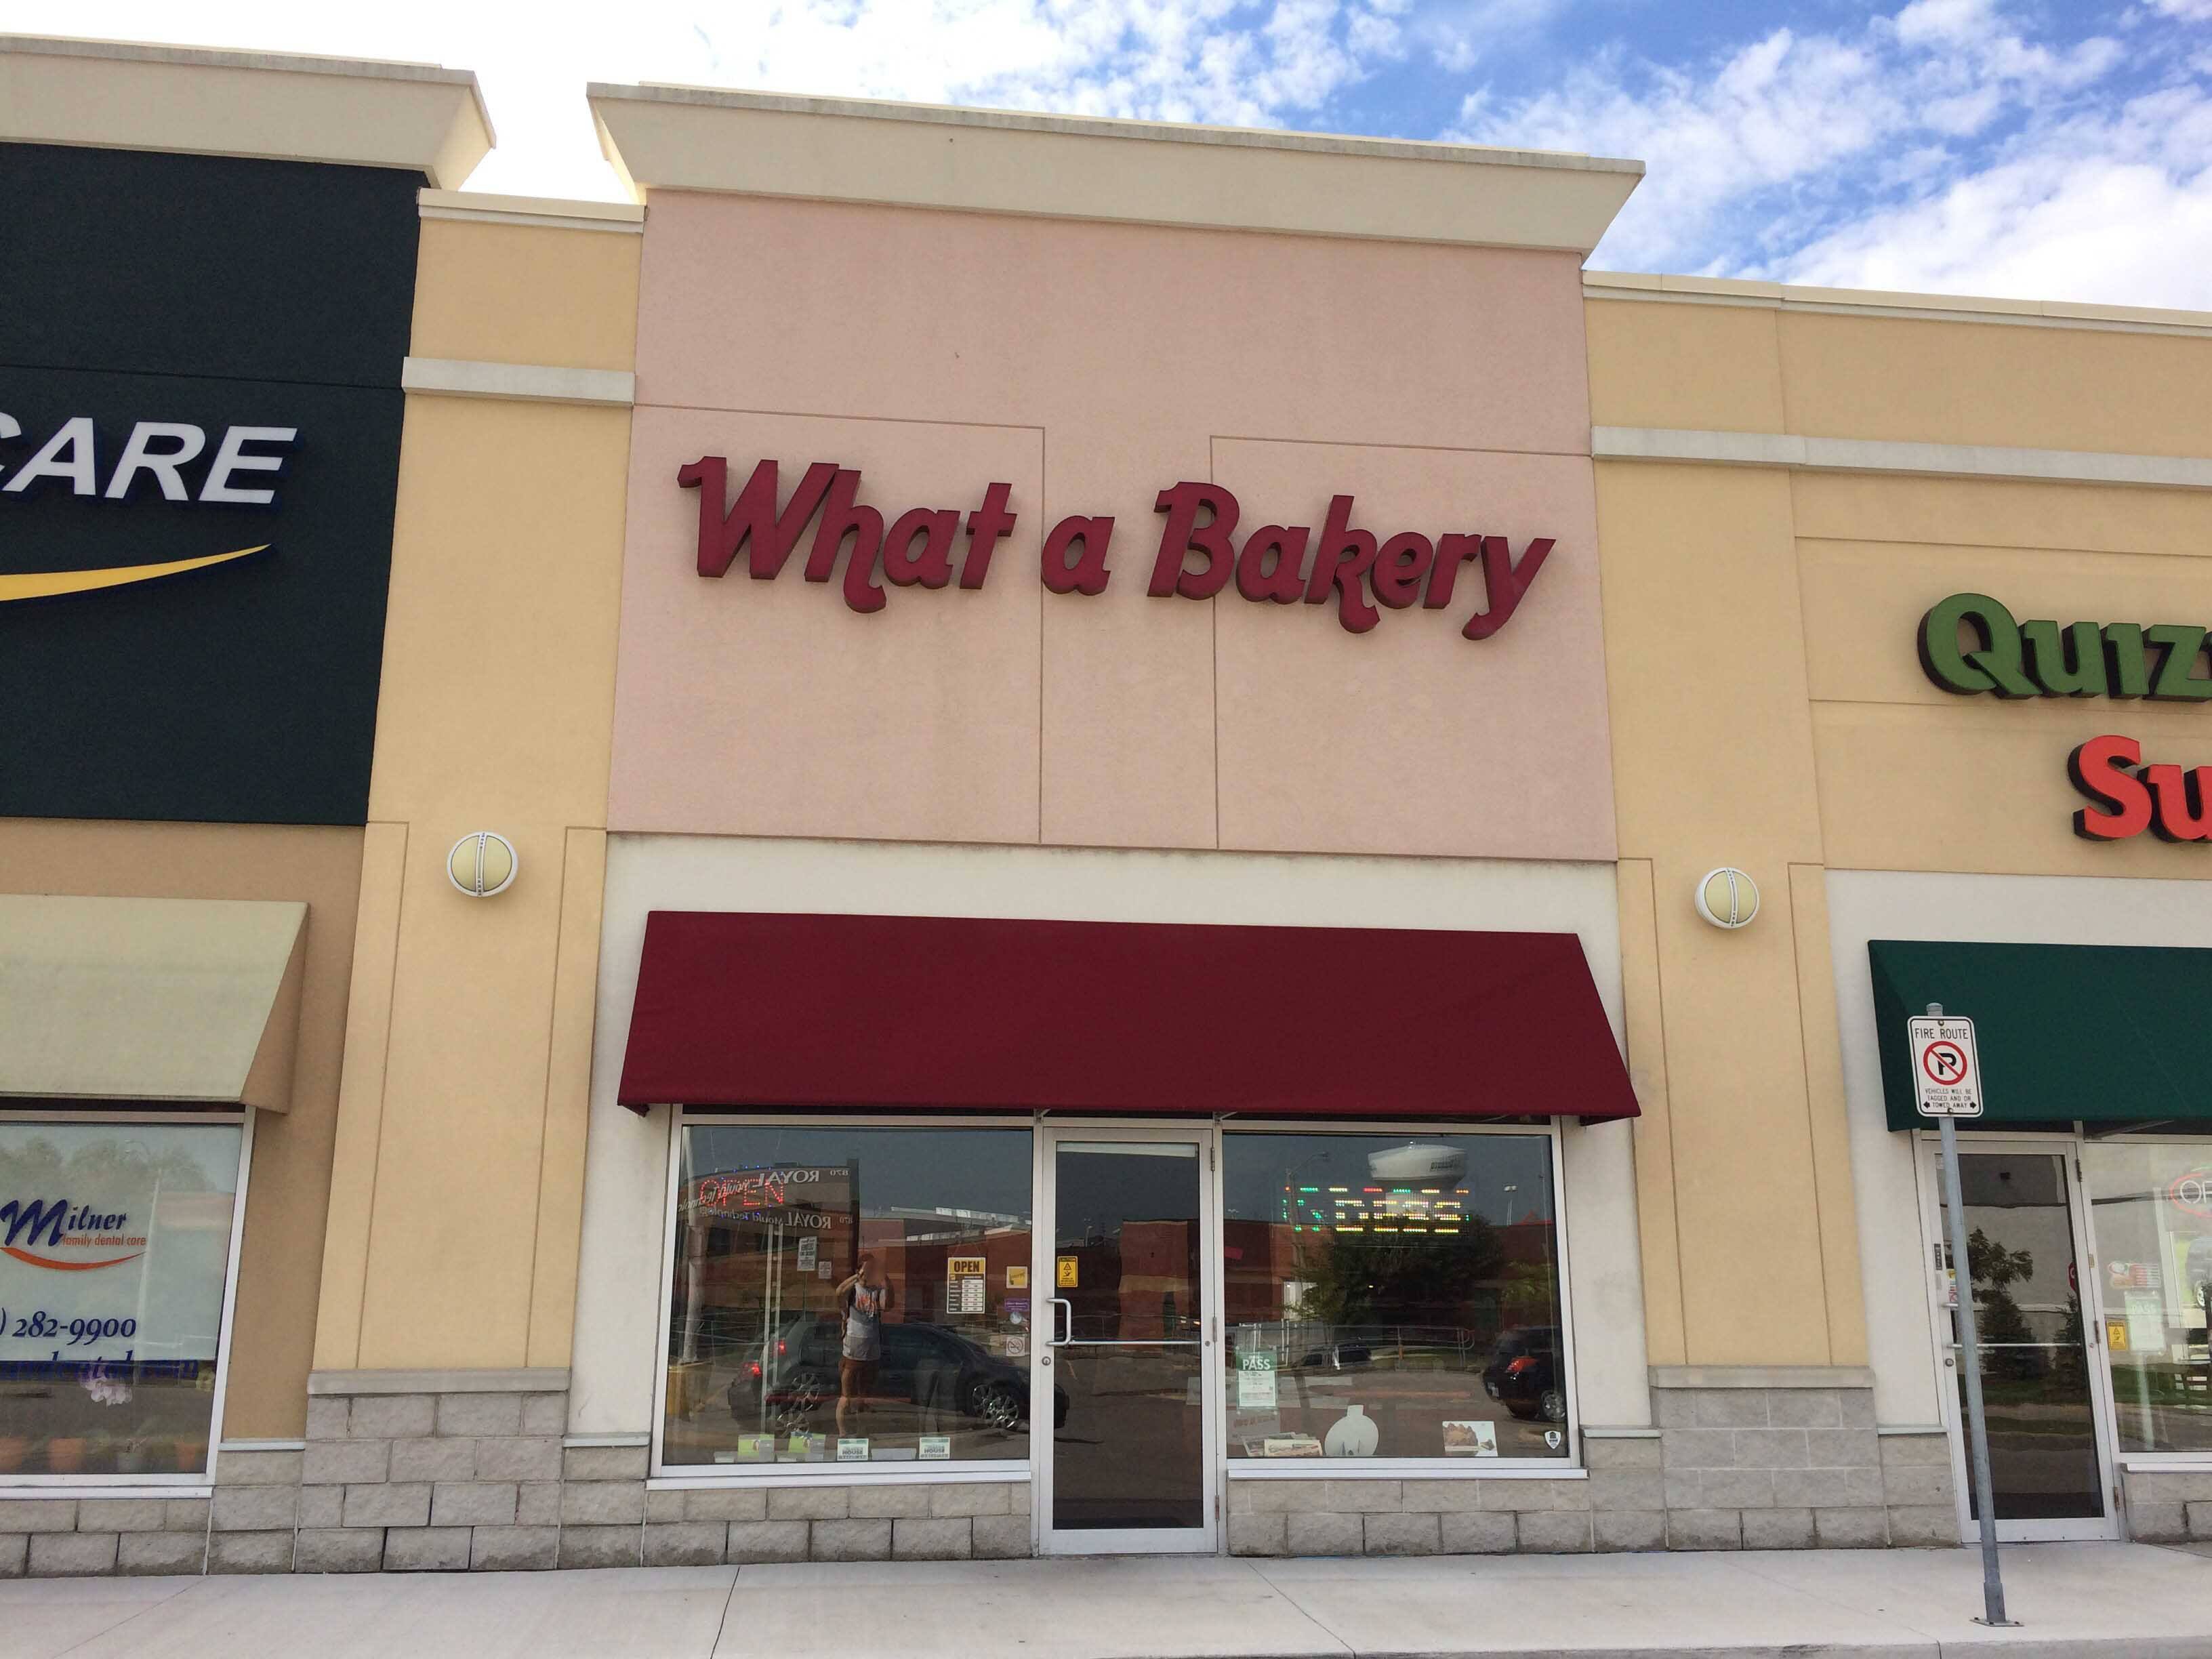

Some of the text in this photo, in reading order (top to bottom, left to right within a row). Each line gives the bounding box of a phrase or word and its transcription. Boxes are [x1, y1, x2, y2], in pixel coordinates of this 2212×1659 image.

[677, 456, 1556, 640] What a Bakery
[1917, 592, 2212, 703] Quiz
[1914, 1027, 1969, 1040] FIRE ROUTE
[699, 1178, 785, 1207] OPEN
[0, 1199, 127, 1246] Milner
[62, 1233, 147, 1248] family dental care
[954, 1261, 980, 1273] OPEN
[12, 1311, 137, 1346] 282-9900
[1242, 1358, 1271, 1370] PASS
